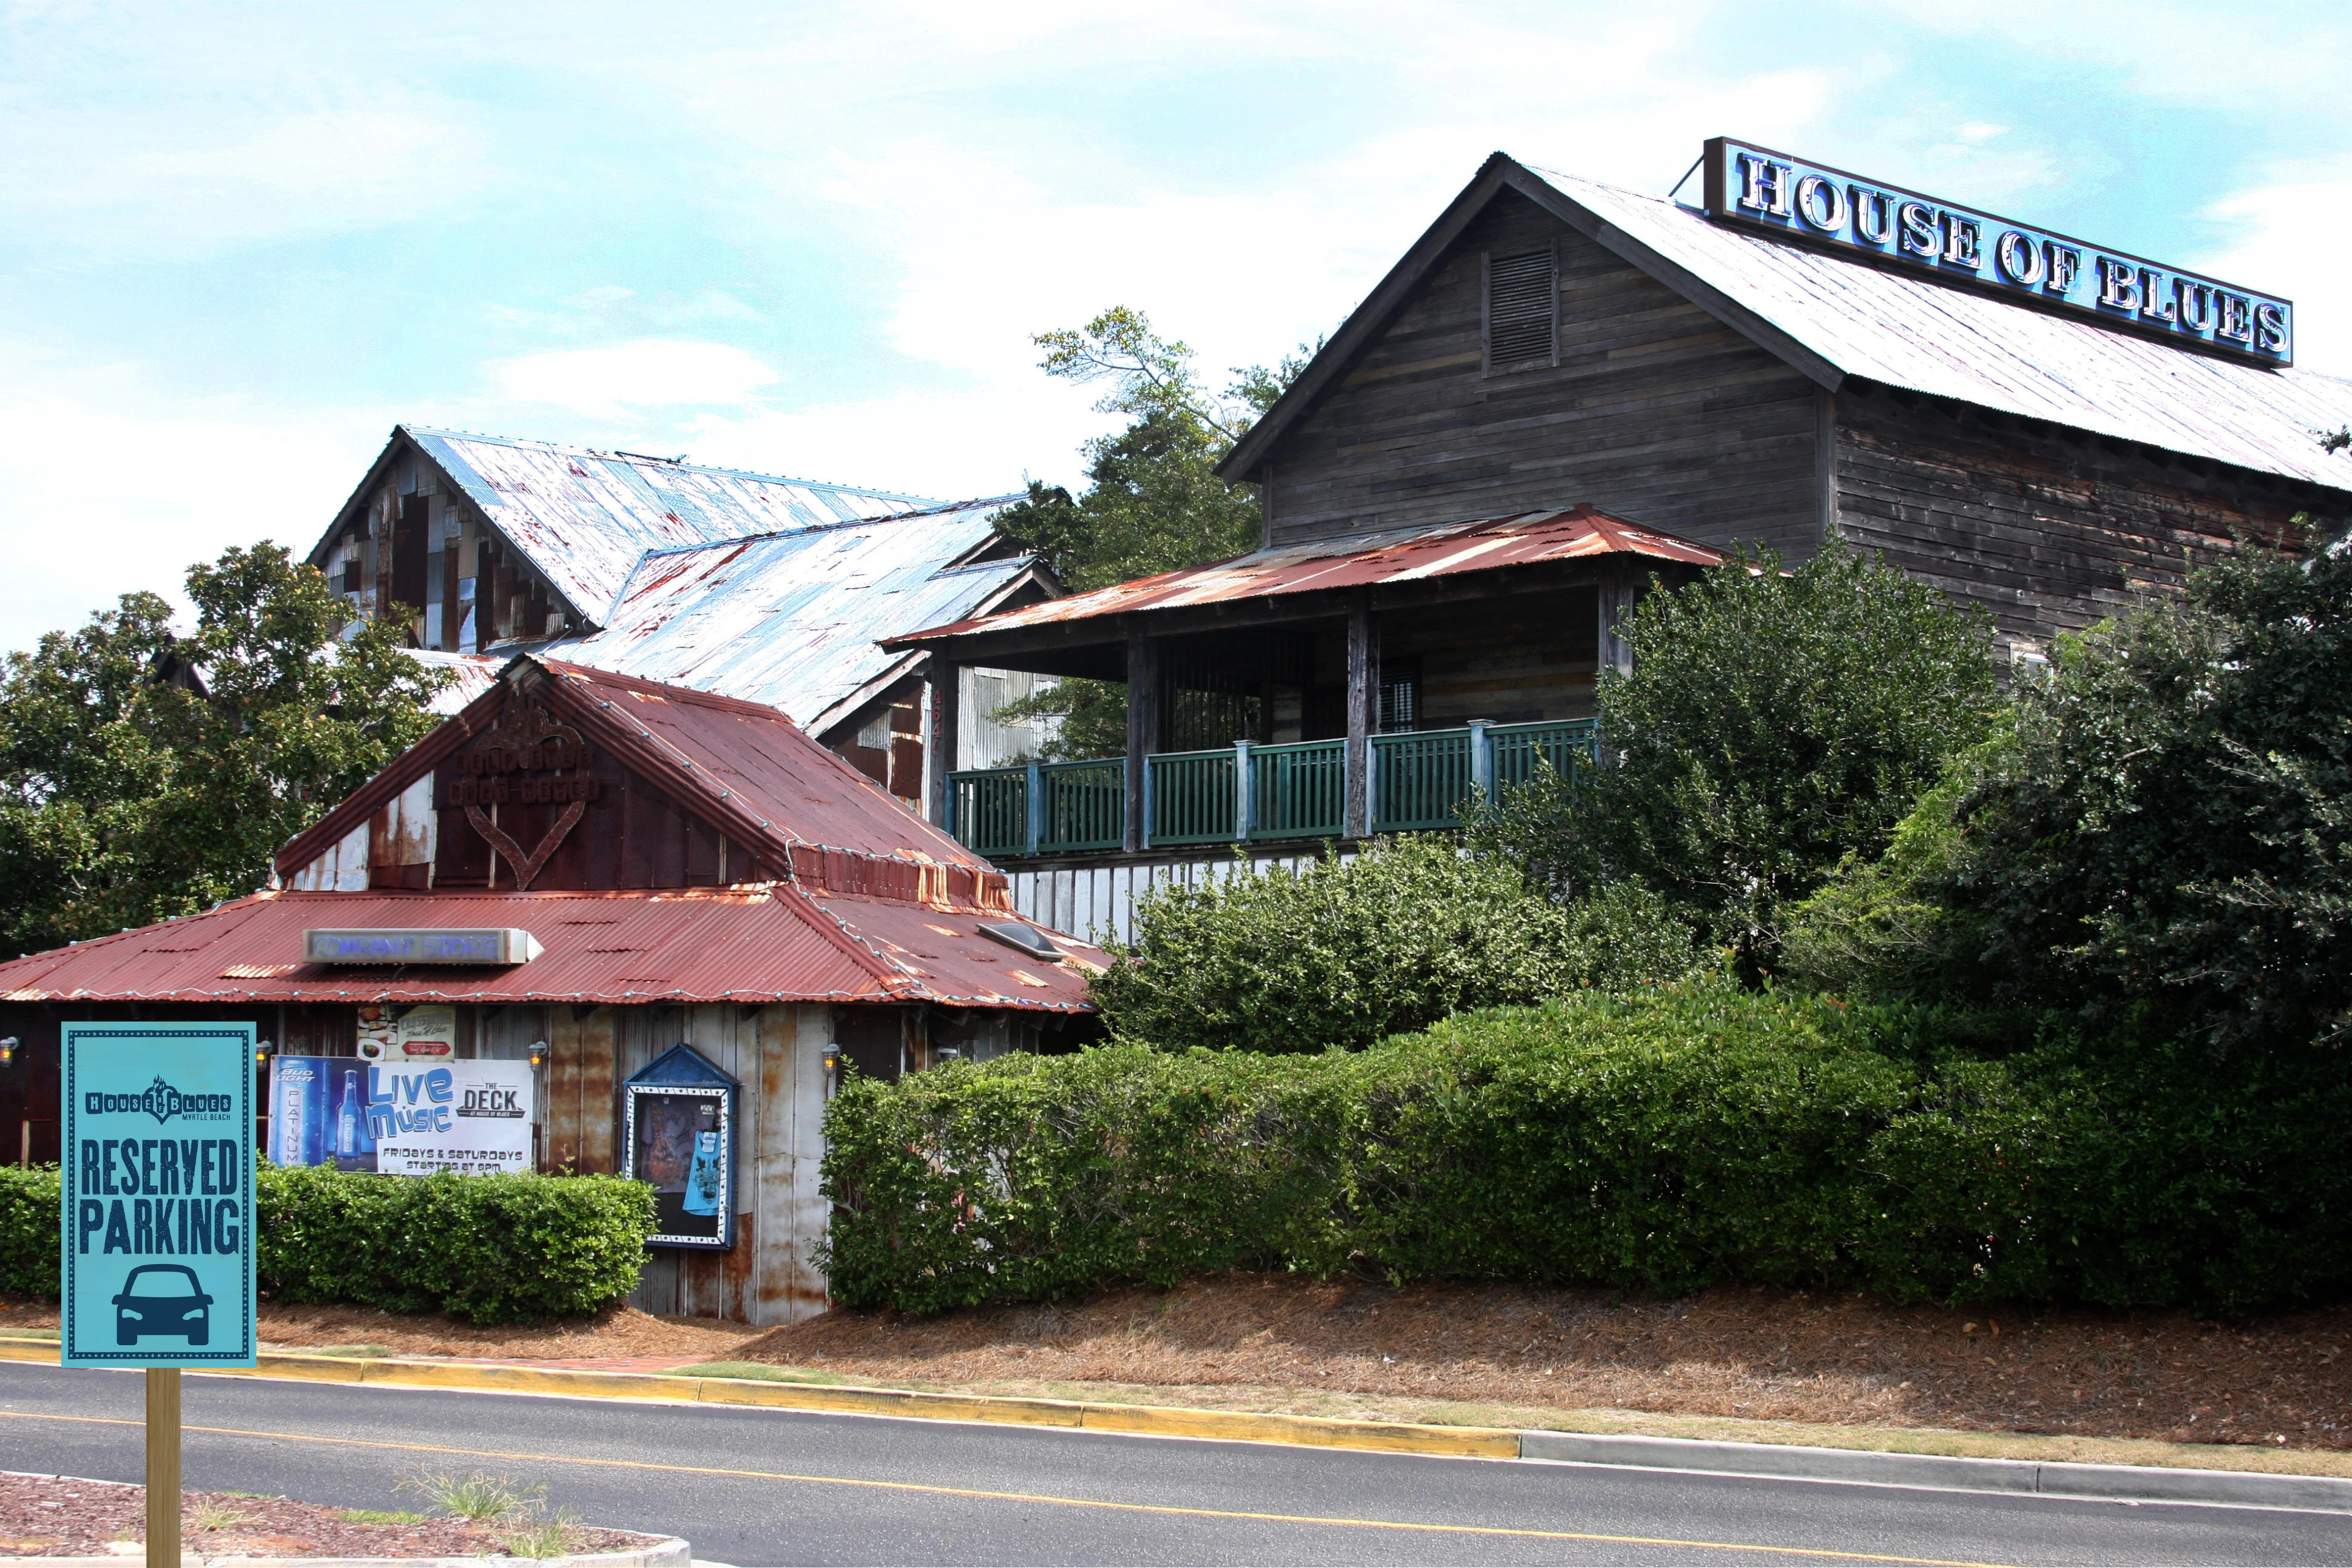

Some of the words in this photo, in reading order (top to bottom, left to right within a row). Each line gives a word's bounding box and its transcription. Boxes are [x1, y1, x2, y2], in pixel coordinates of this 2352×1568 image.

[1738, 153, 1983, 269] HOUSE
[2000, 230, 2083, 293] OF
[2097, 255, 2288, 352] BLUES
[314, 937, 414, 957] COMPANY
[422, 937, 497, 957] STORE
[88, 1093, 153, 1113] HOUSE
[168, 1094, 230, 1113] BLUES
[464, 1089, 518, 1110] DECK
[287, 1090, 300, 1161] PLATINUM
[81, 1138, 238, 1196] RESERVED
[437, 1149, 444, 1159] &
[79, 1198, 239, 1255] PARKING
